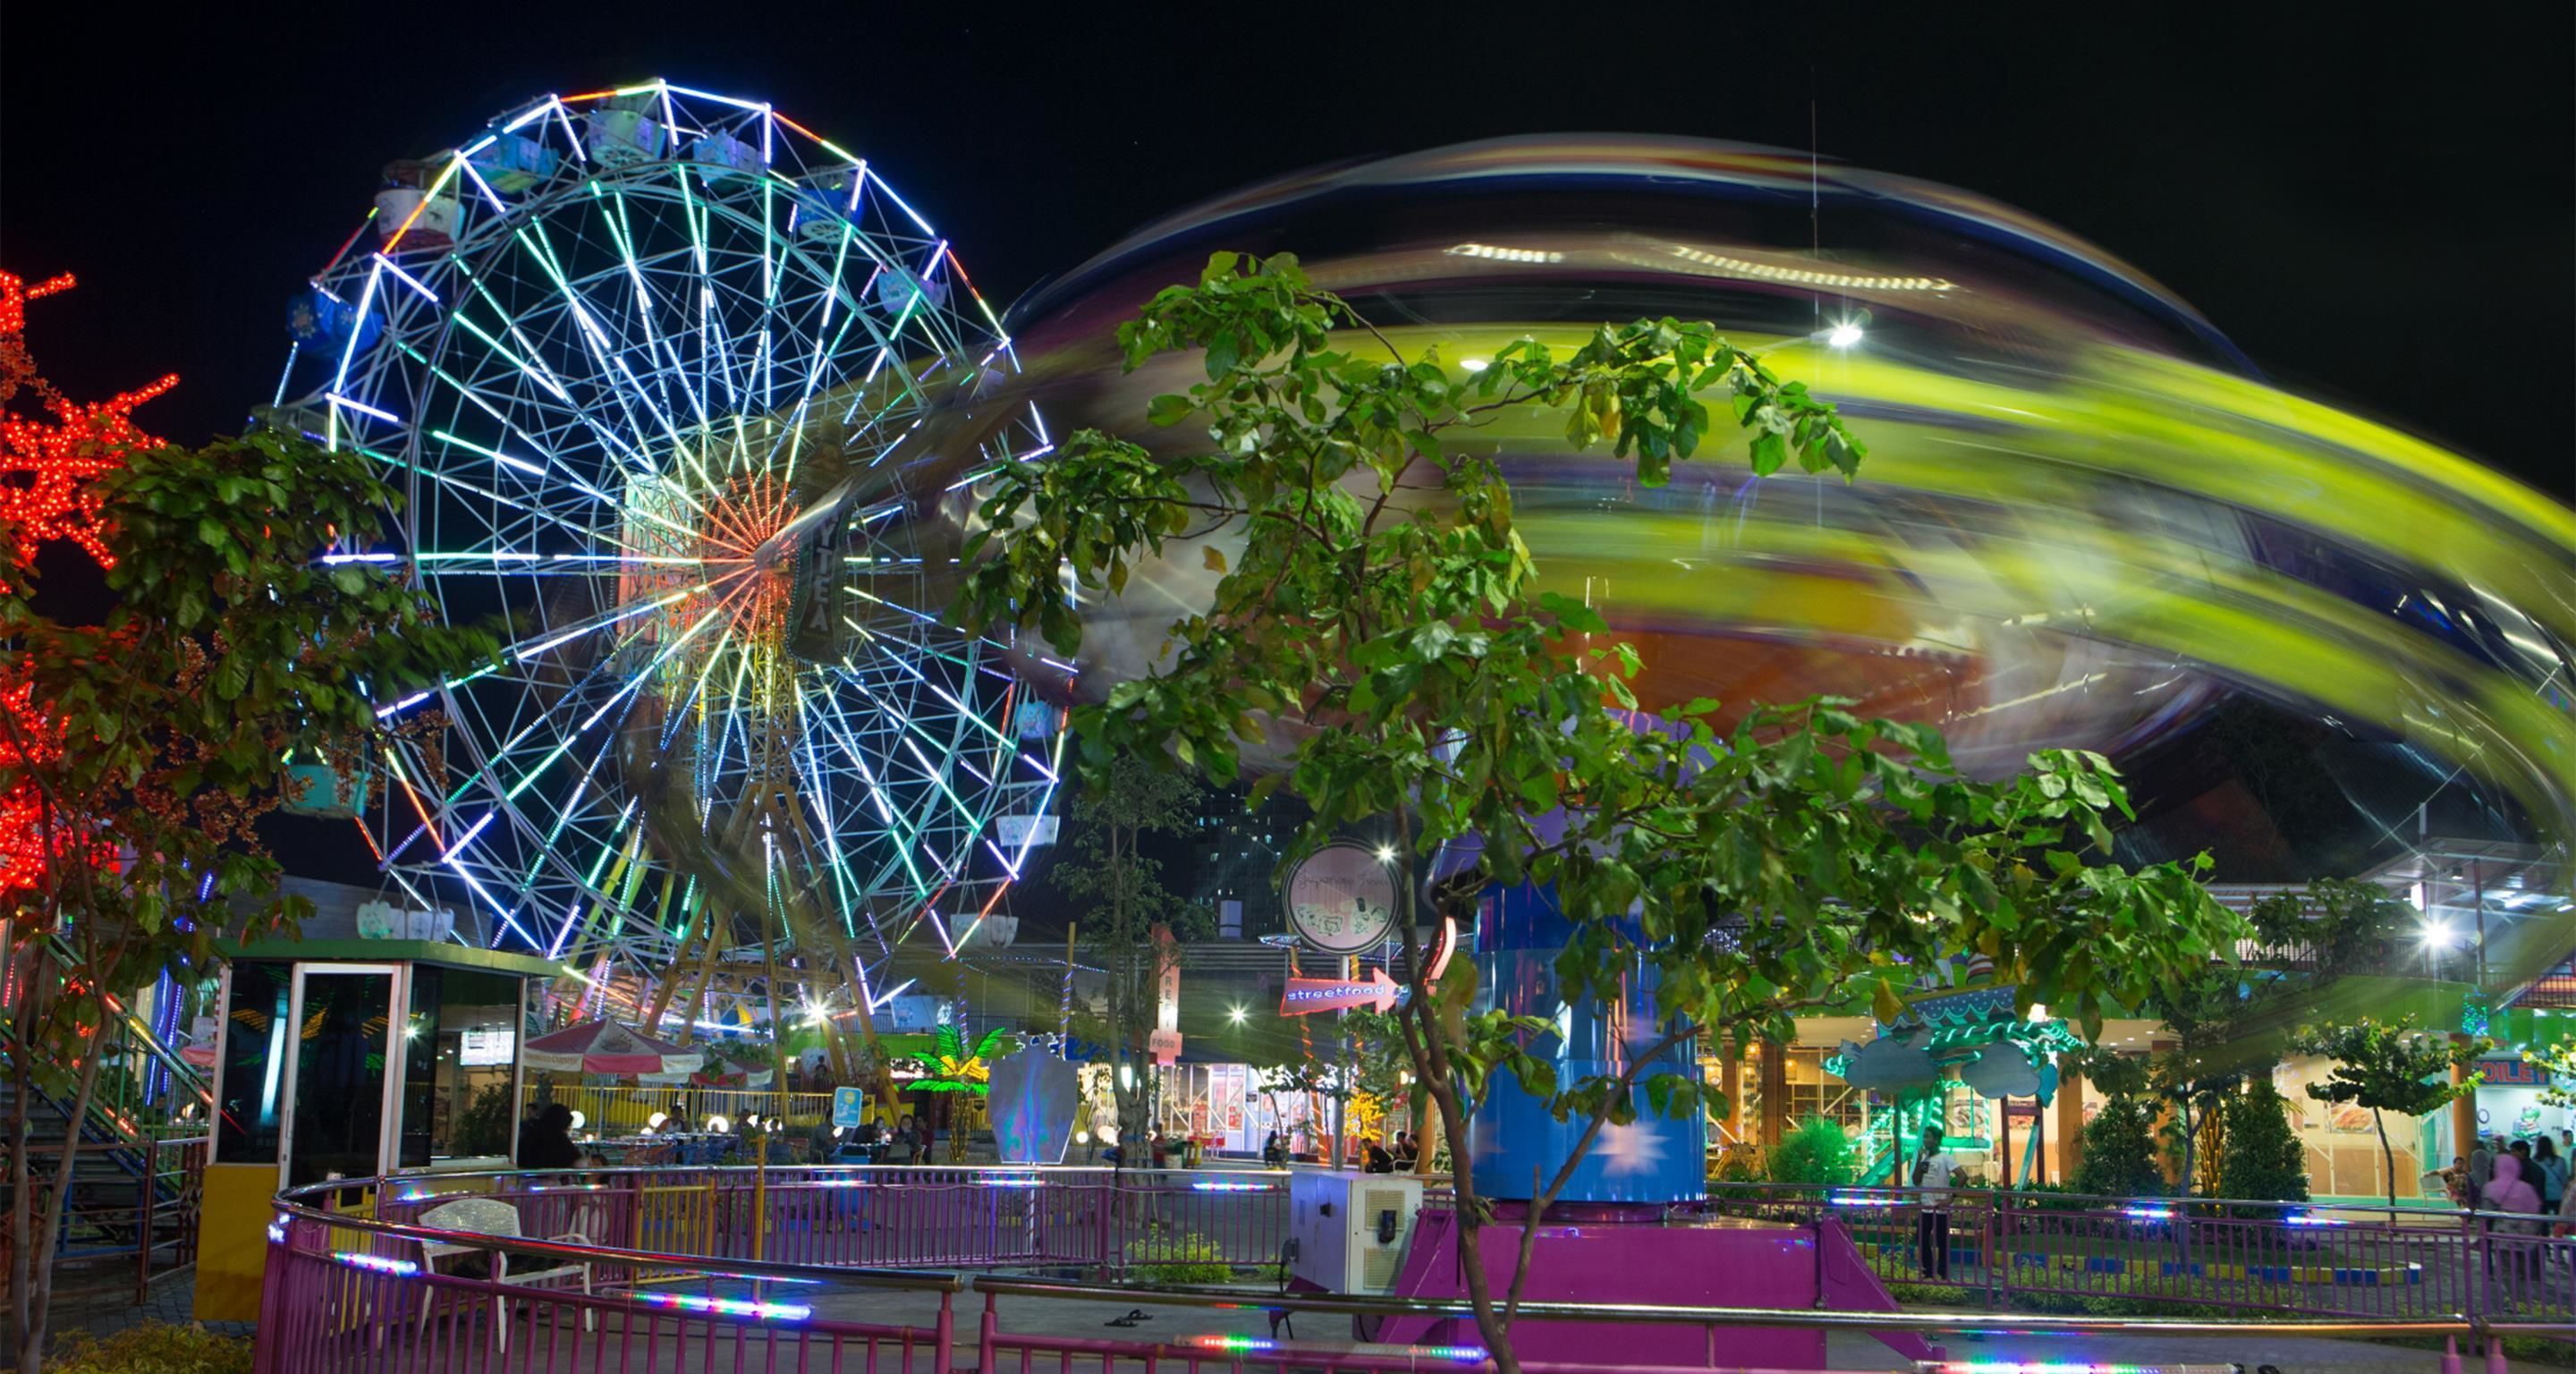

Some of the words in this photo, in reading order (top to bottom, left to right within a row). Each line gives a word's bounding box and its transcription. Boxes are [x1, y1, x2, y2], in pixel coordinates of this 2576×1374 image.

[809, 513, 838, 631] YTEA
[1286, 984, 1385, 1002] streetfood
[1151, 1039, 1175, 1049] FOOD
[2475, 1061, 2546, 1083] OILE
